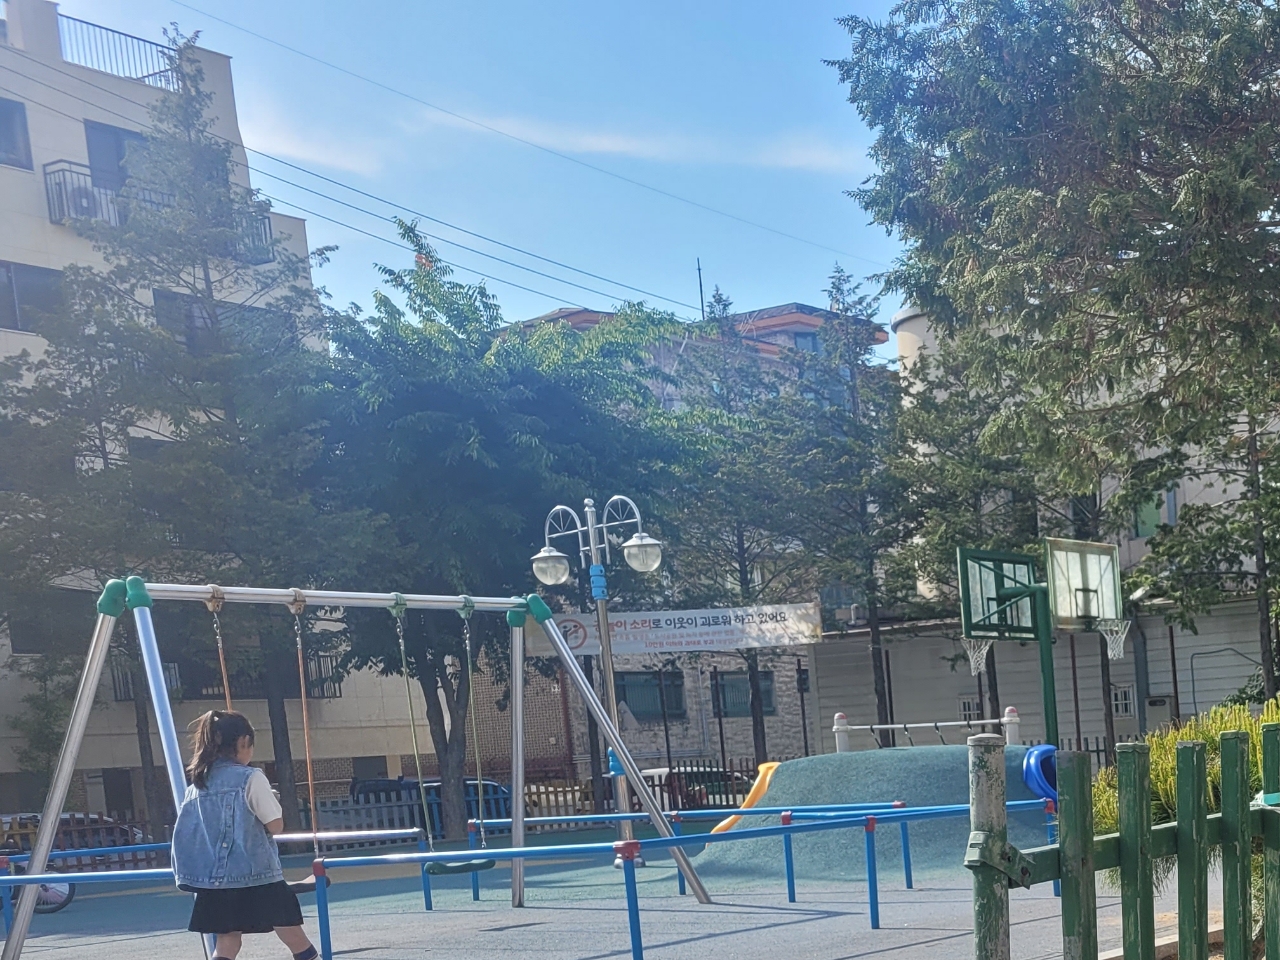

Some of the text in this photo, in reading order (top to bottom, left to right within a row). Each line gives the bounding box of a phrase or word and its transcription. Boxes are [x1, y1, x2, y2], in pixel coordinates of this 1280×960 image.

[629, 618, 664, 630] 소리로
[665, 616, 698, 630] 이웃이
[700, 615, 732, 627] 괴로워
[734, 613, 756, 626] 하고
[757, 611, 788, 624] 있어요
